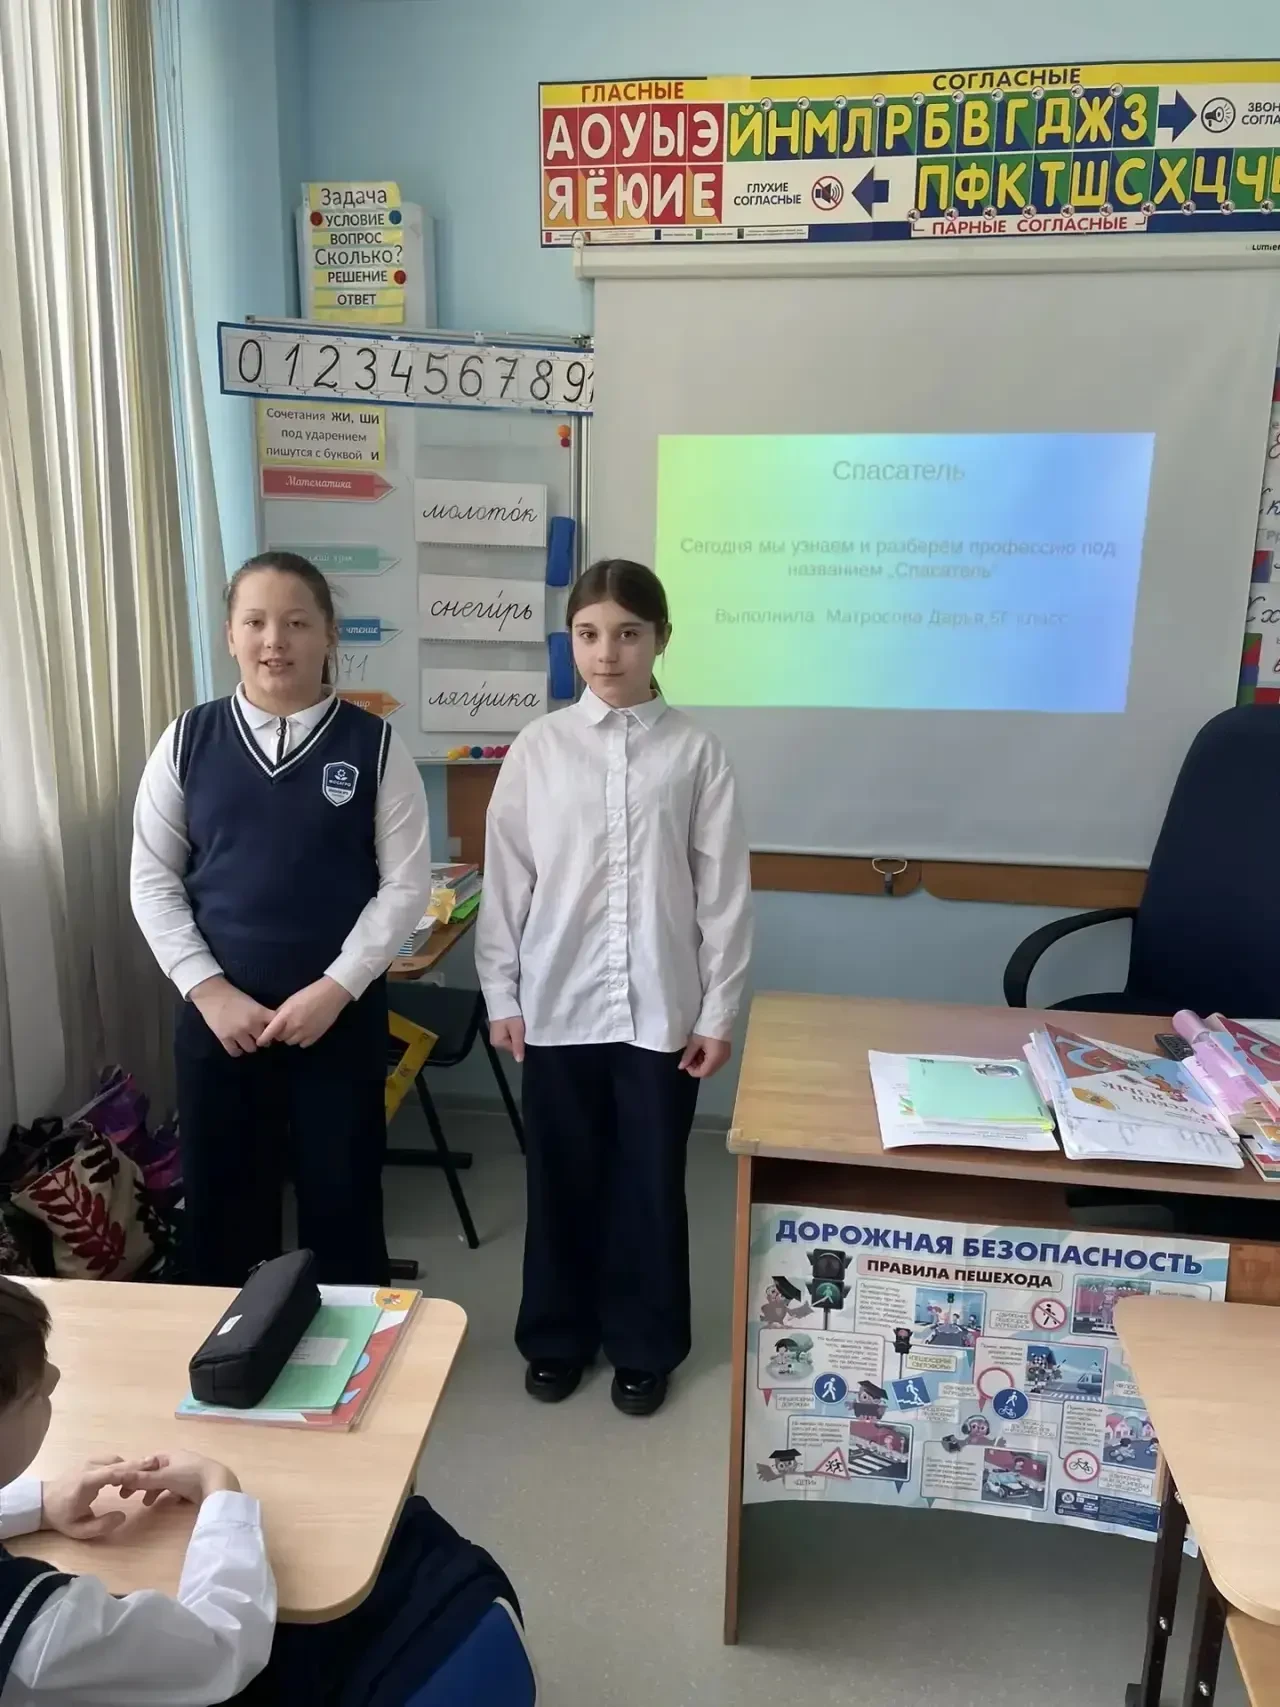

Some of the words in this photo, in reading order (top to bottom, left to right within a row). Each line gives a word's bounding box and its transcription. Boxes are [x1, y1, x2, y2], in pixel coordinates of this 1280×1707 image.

[932, 68, 1081, 90] СОГЛАСНЫЕ
[581, 82, 684, 103] ГЛАСНЫЕ
[746, 182, 789, 194] ГЛУХИЕ
[321, 188, 388, 208] Задача
[734, 194, 802, 206] СОГЛАСНЫЕ
[326, 213, 384, 227] УСЛОВИЕ
[932, 220, 1006, 235] ПАРНЫЕ
[1017, 217, 1128, 232] СОГЛАСНЫЕ
[330, 232, 382, 245] ВОПРОС
[314, 245, 403, 266] Сколько?
[328, 270, 388, 284] РЕШЕНИЕ
[337, 294, 376, 306] ОТВЕТ
[266, 408, 326, 422] Сочетания
[331, 412, 354, 424] ЖИ,
[360, 414, 380, 424] ШИ
[281, 429, 303, 440] под
[305, 430, 367, 444] ударением
[266, 448, 312, 459] пишутся
[324, 447, 362, 462] буквой
[832, 460, 966, 482] Спасатель
[285, 474, 352, 489] Математика
[680, 537, 752, 557] Сегодня
[758, 540, 786, 554] мы
[791, 540, 854, 558] узнаем
[860, 540, 870, 554] и
[968, 538, 1074, 558] профессию
[1080, 540, 1117, 558] под
[788, 563, 883, 577] названием
[826, 609, 923, 628] Матросова
[776, 1220, 954, 1255] ДОРОЖНАЯ
[962, 1238, 1203, 1275] БЕЗОПАСНОСТЬ
[867, 1260, 950, 1280] ПРАВИЛА
[954, 1269, 1053, 1288] ПЕШЕХОДА
